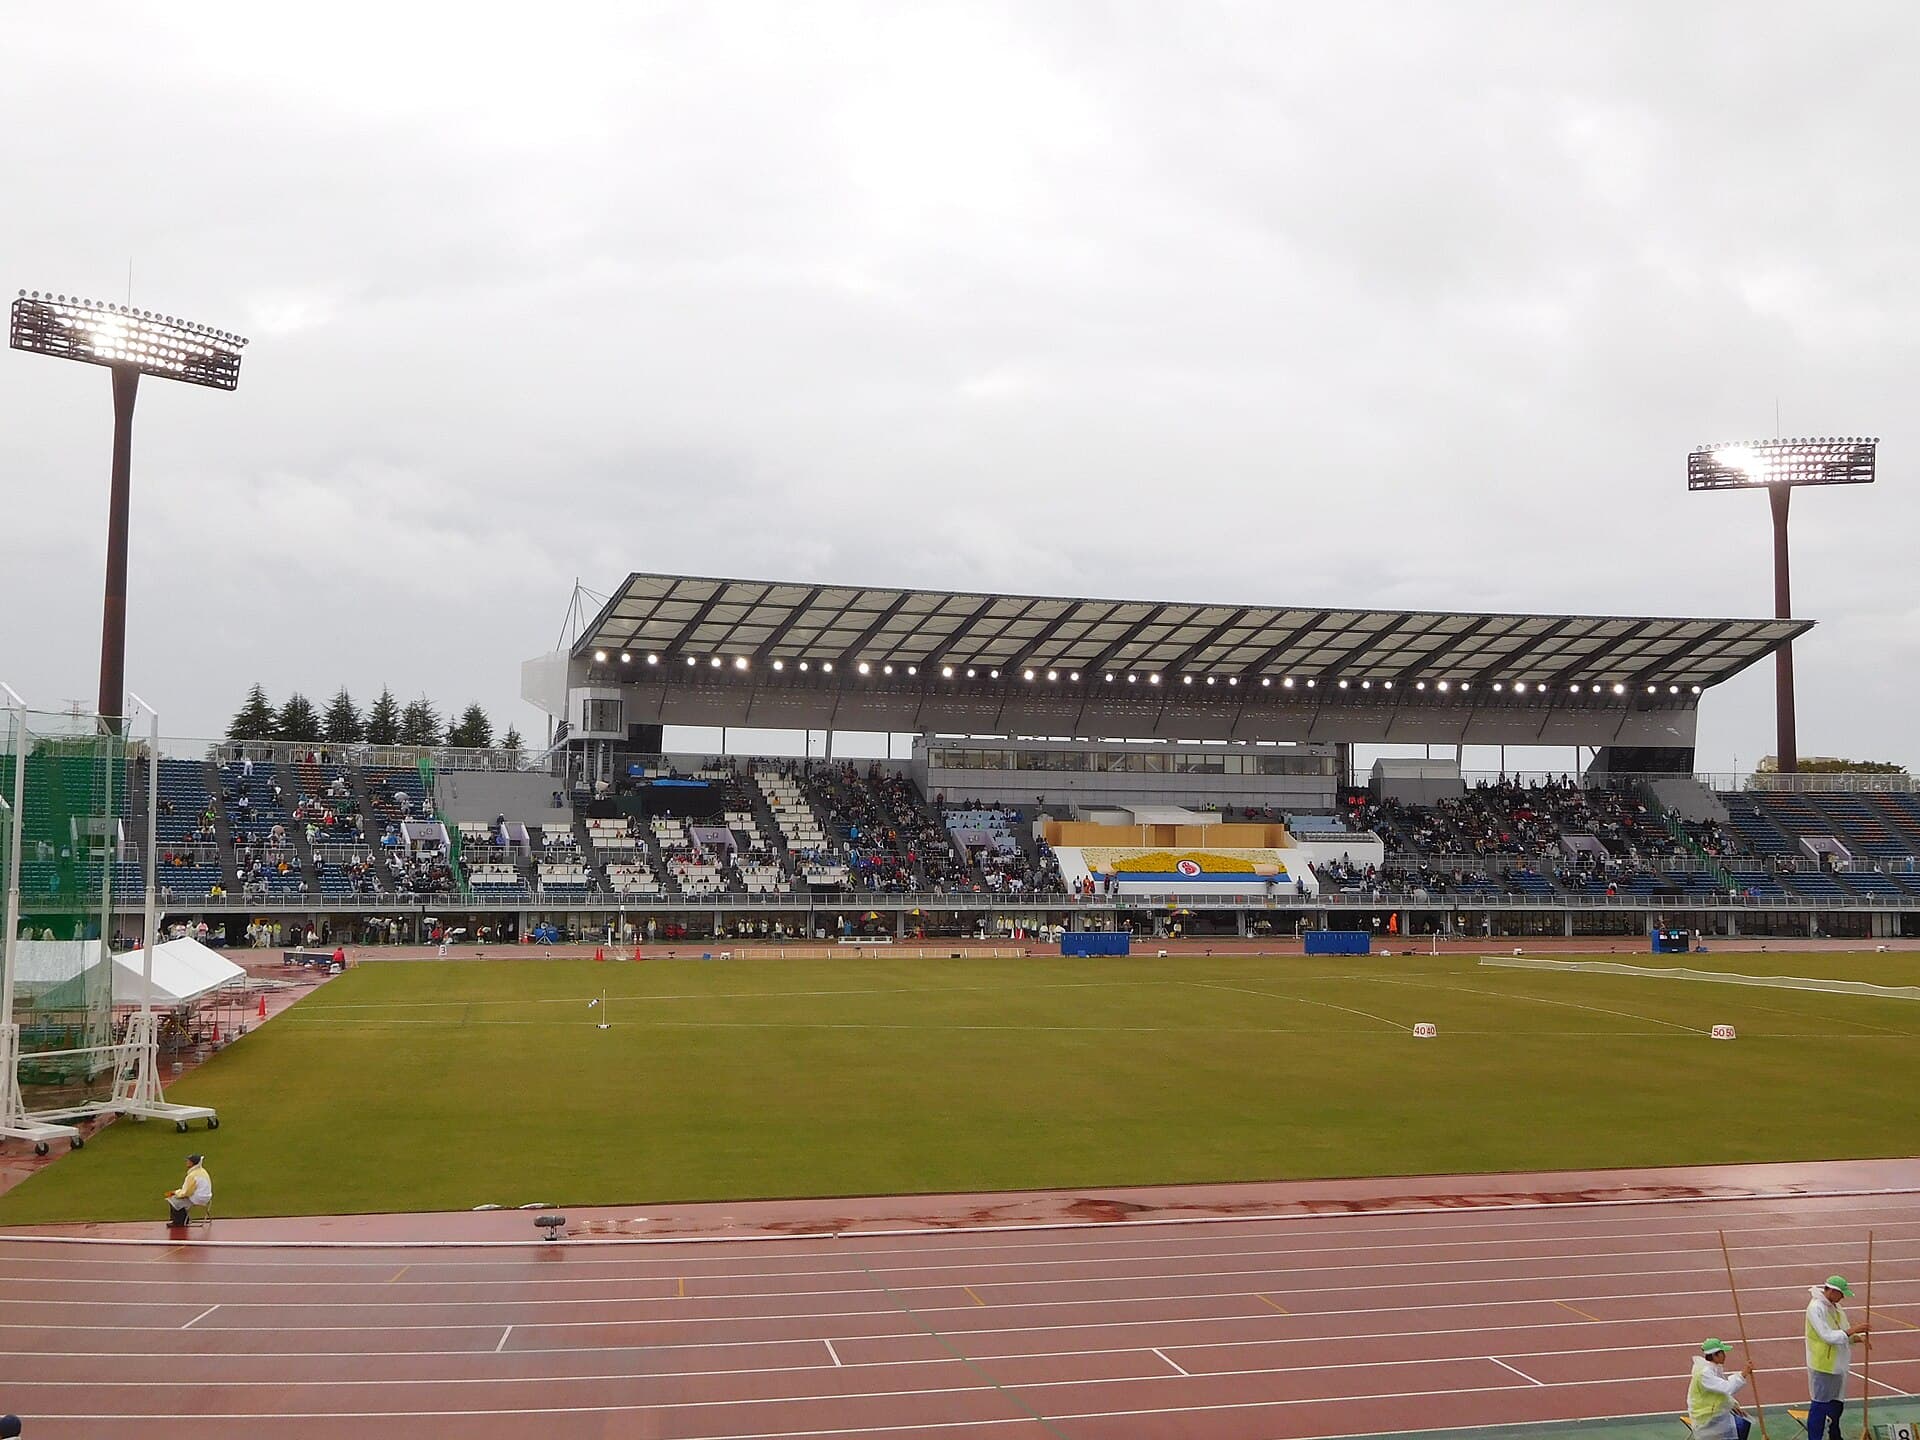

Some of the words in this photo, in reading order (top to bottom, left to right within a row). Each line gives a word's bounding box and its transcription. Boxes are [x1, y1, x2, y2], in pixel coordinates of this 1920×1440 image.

[1415, 1026, 1426, 1035] 40
[1427, 1026, 1435, 1035] 40
[1713, 1028, 1725, 1036] 50
[1726, 1028, 1734, 1037] 50
